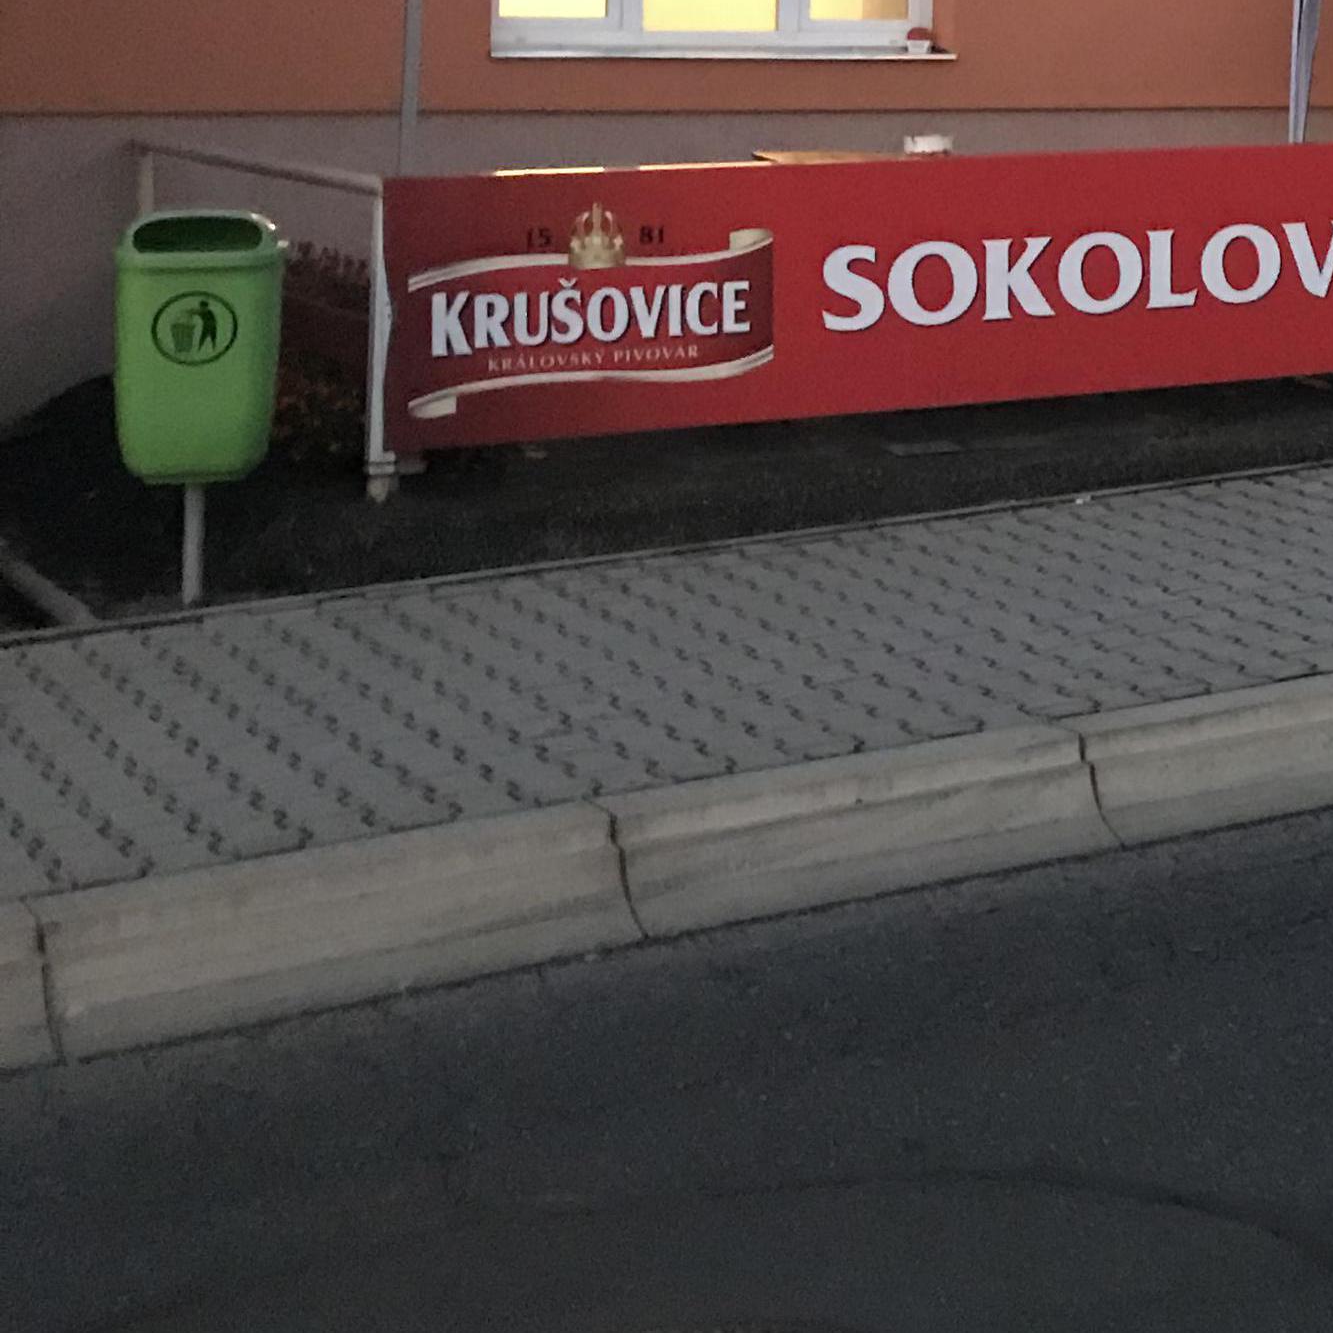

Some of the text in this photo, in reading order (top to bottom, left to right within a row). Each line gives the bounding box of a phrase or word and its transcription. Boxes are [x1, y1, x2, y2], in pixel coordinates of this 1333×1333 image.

[430, 277, 752, 358] KRUŠOVICE
[487, 343, 699, 372] KRÁLOVSKÝ PIVOVAR
